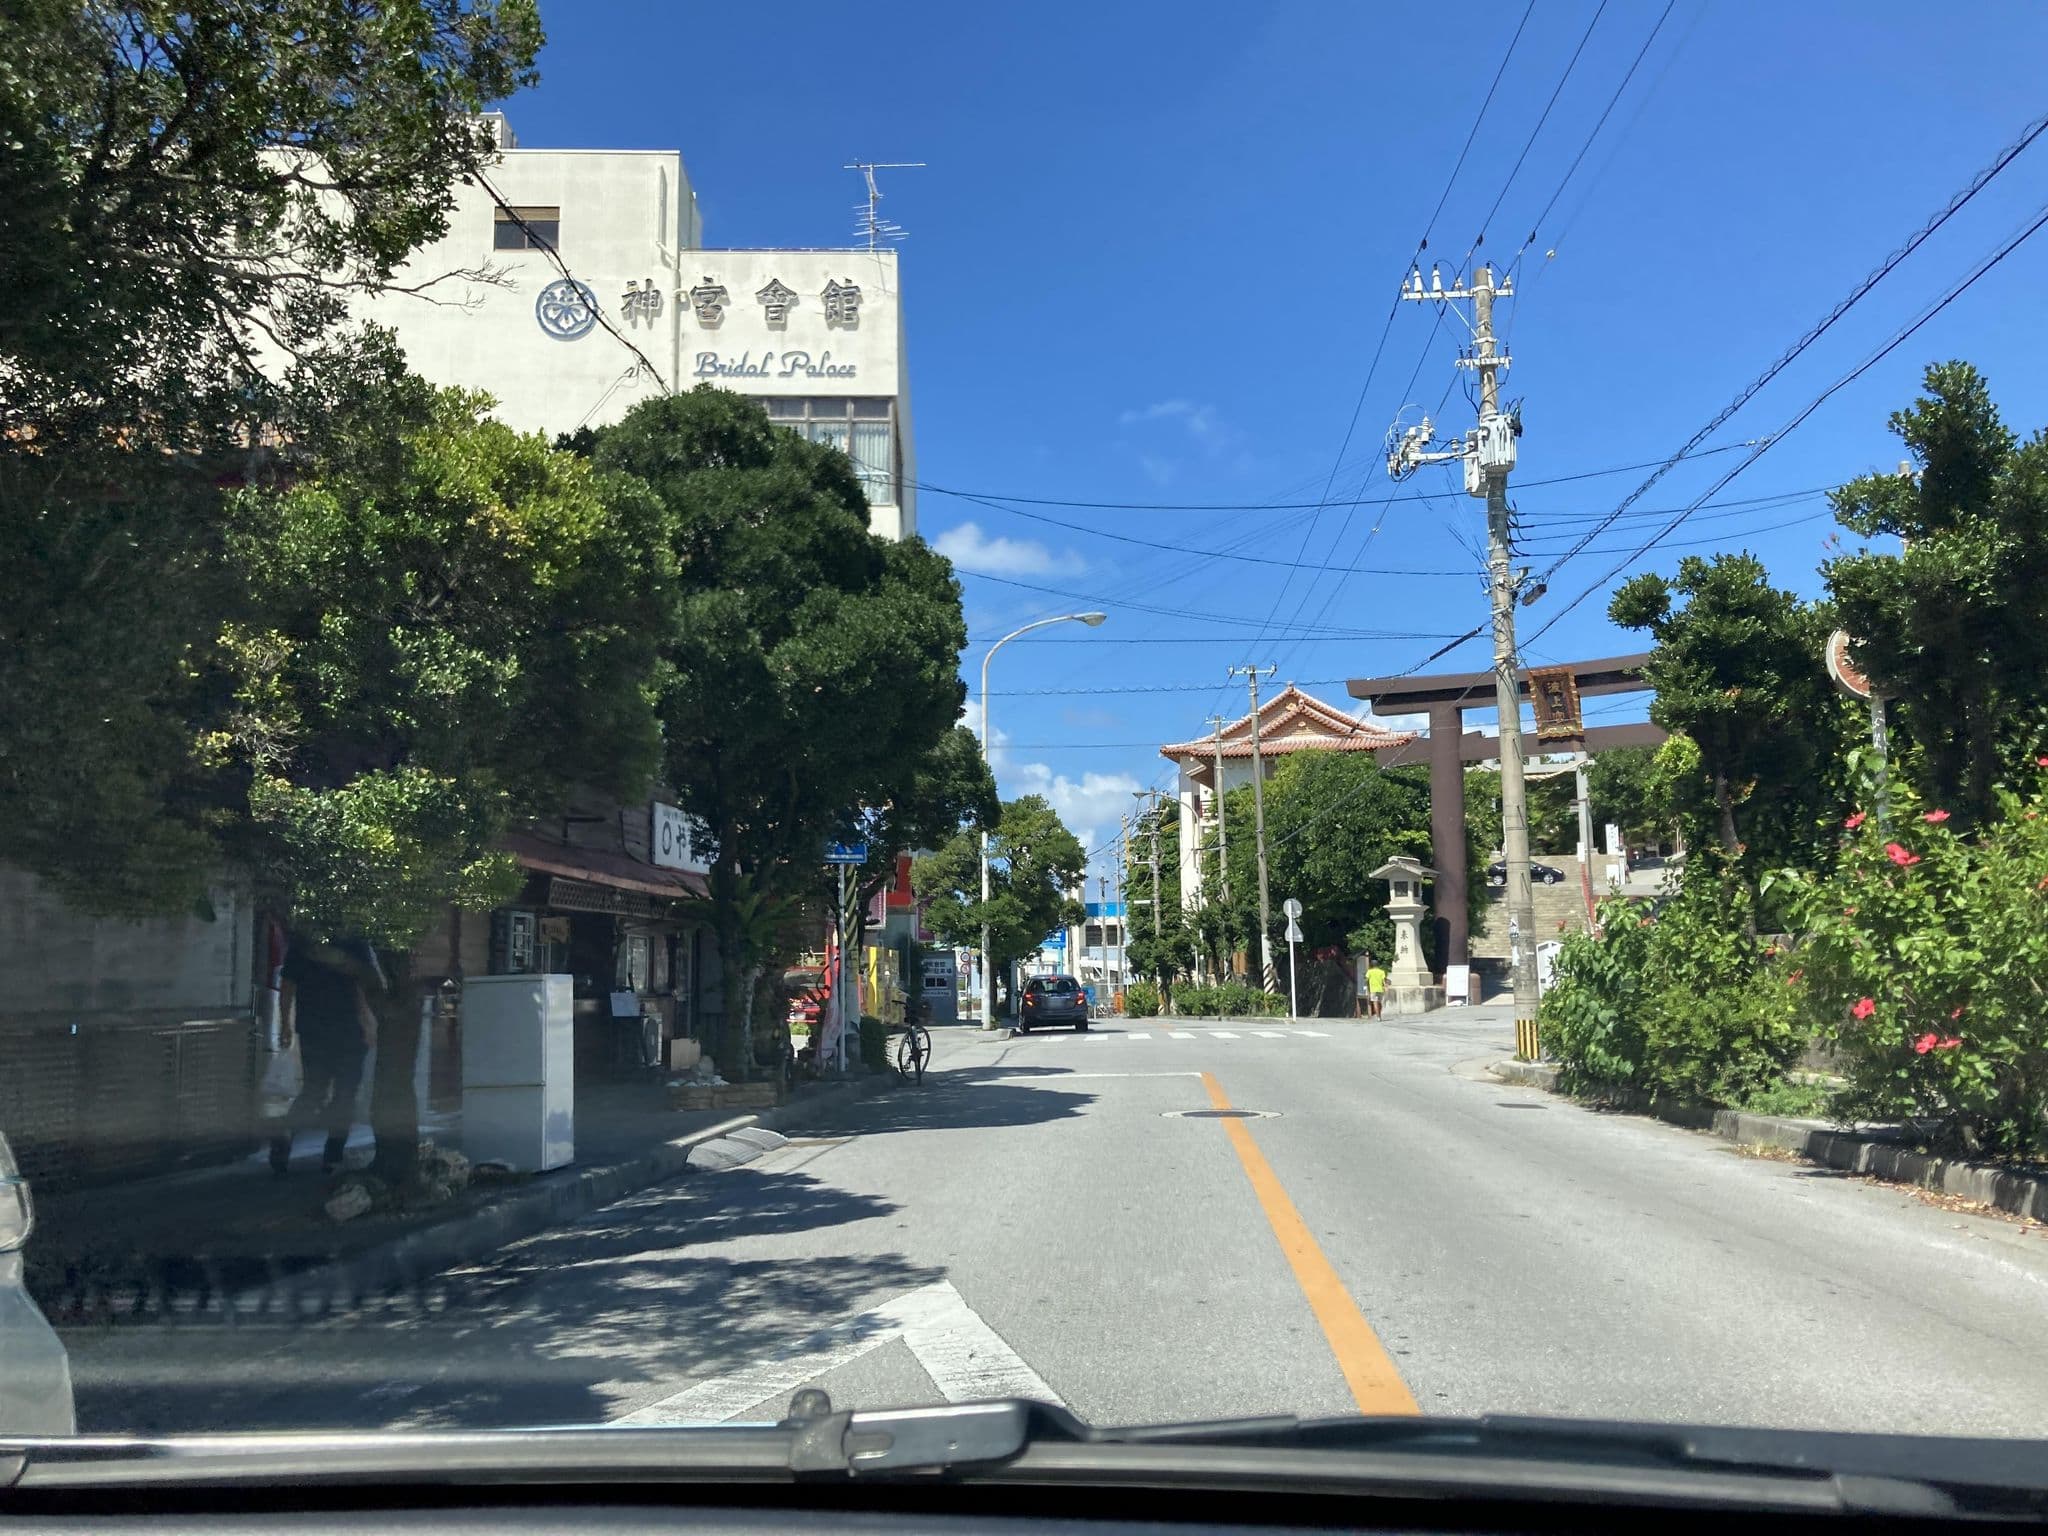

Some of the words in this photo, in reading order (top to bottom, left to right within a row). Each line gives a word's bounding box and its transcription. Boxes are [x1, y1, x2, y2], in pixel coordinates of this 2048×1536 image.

[621, 276, 860, 325] 神宮會館
[692, 350, 774, 378] Bridal
[777, 350, 857, 378] Palace
